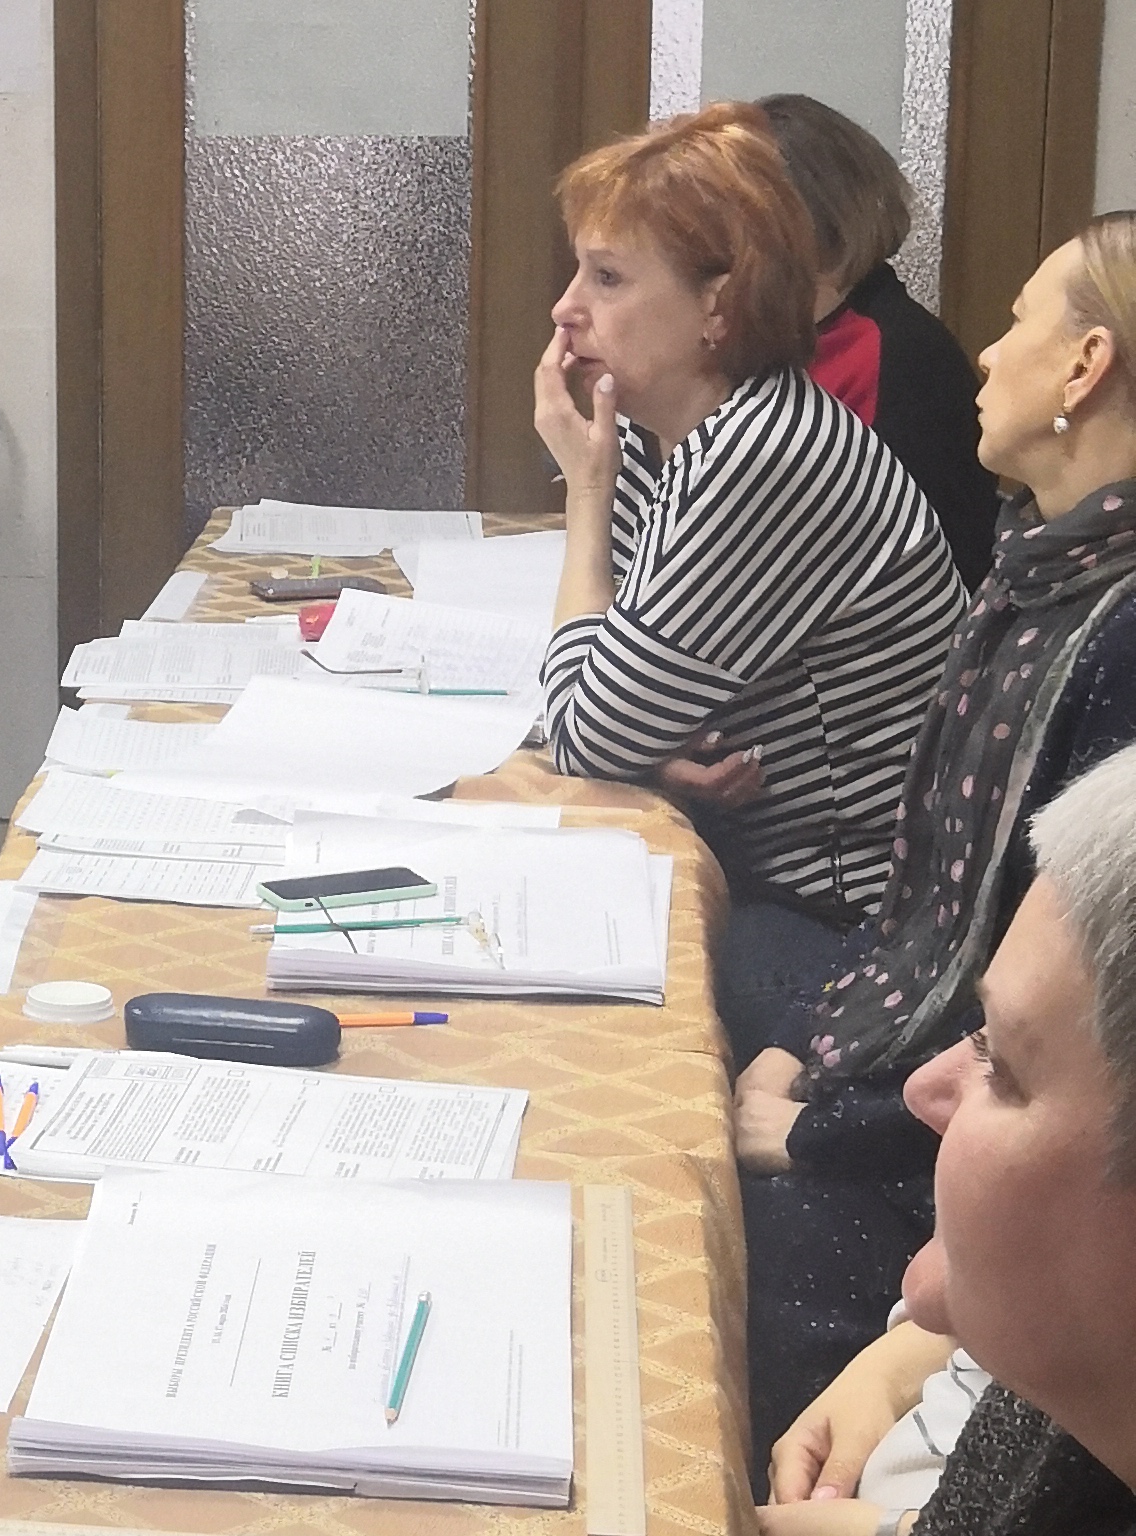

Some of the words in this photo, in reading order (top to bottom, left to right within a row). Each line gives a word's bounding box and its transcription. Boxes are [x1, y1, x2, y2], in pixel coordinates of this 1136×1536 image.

[288, 1251, 316, 1320] ИЗБИРАТЕЛЕЙ
[279, 1322, 302, 1361] СПИСКА
[165, 1368, 183, 1398] ВЫБОРЫ
[272, 1363, 294, 1398] КНИГА
